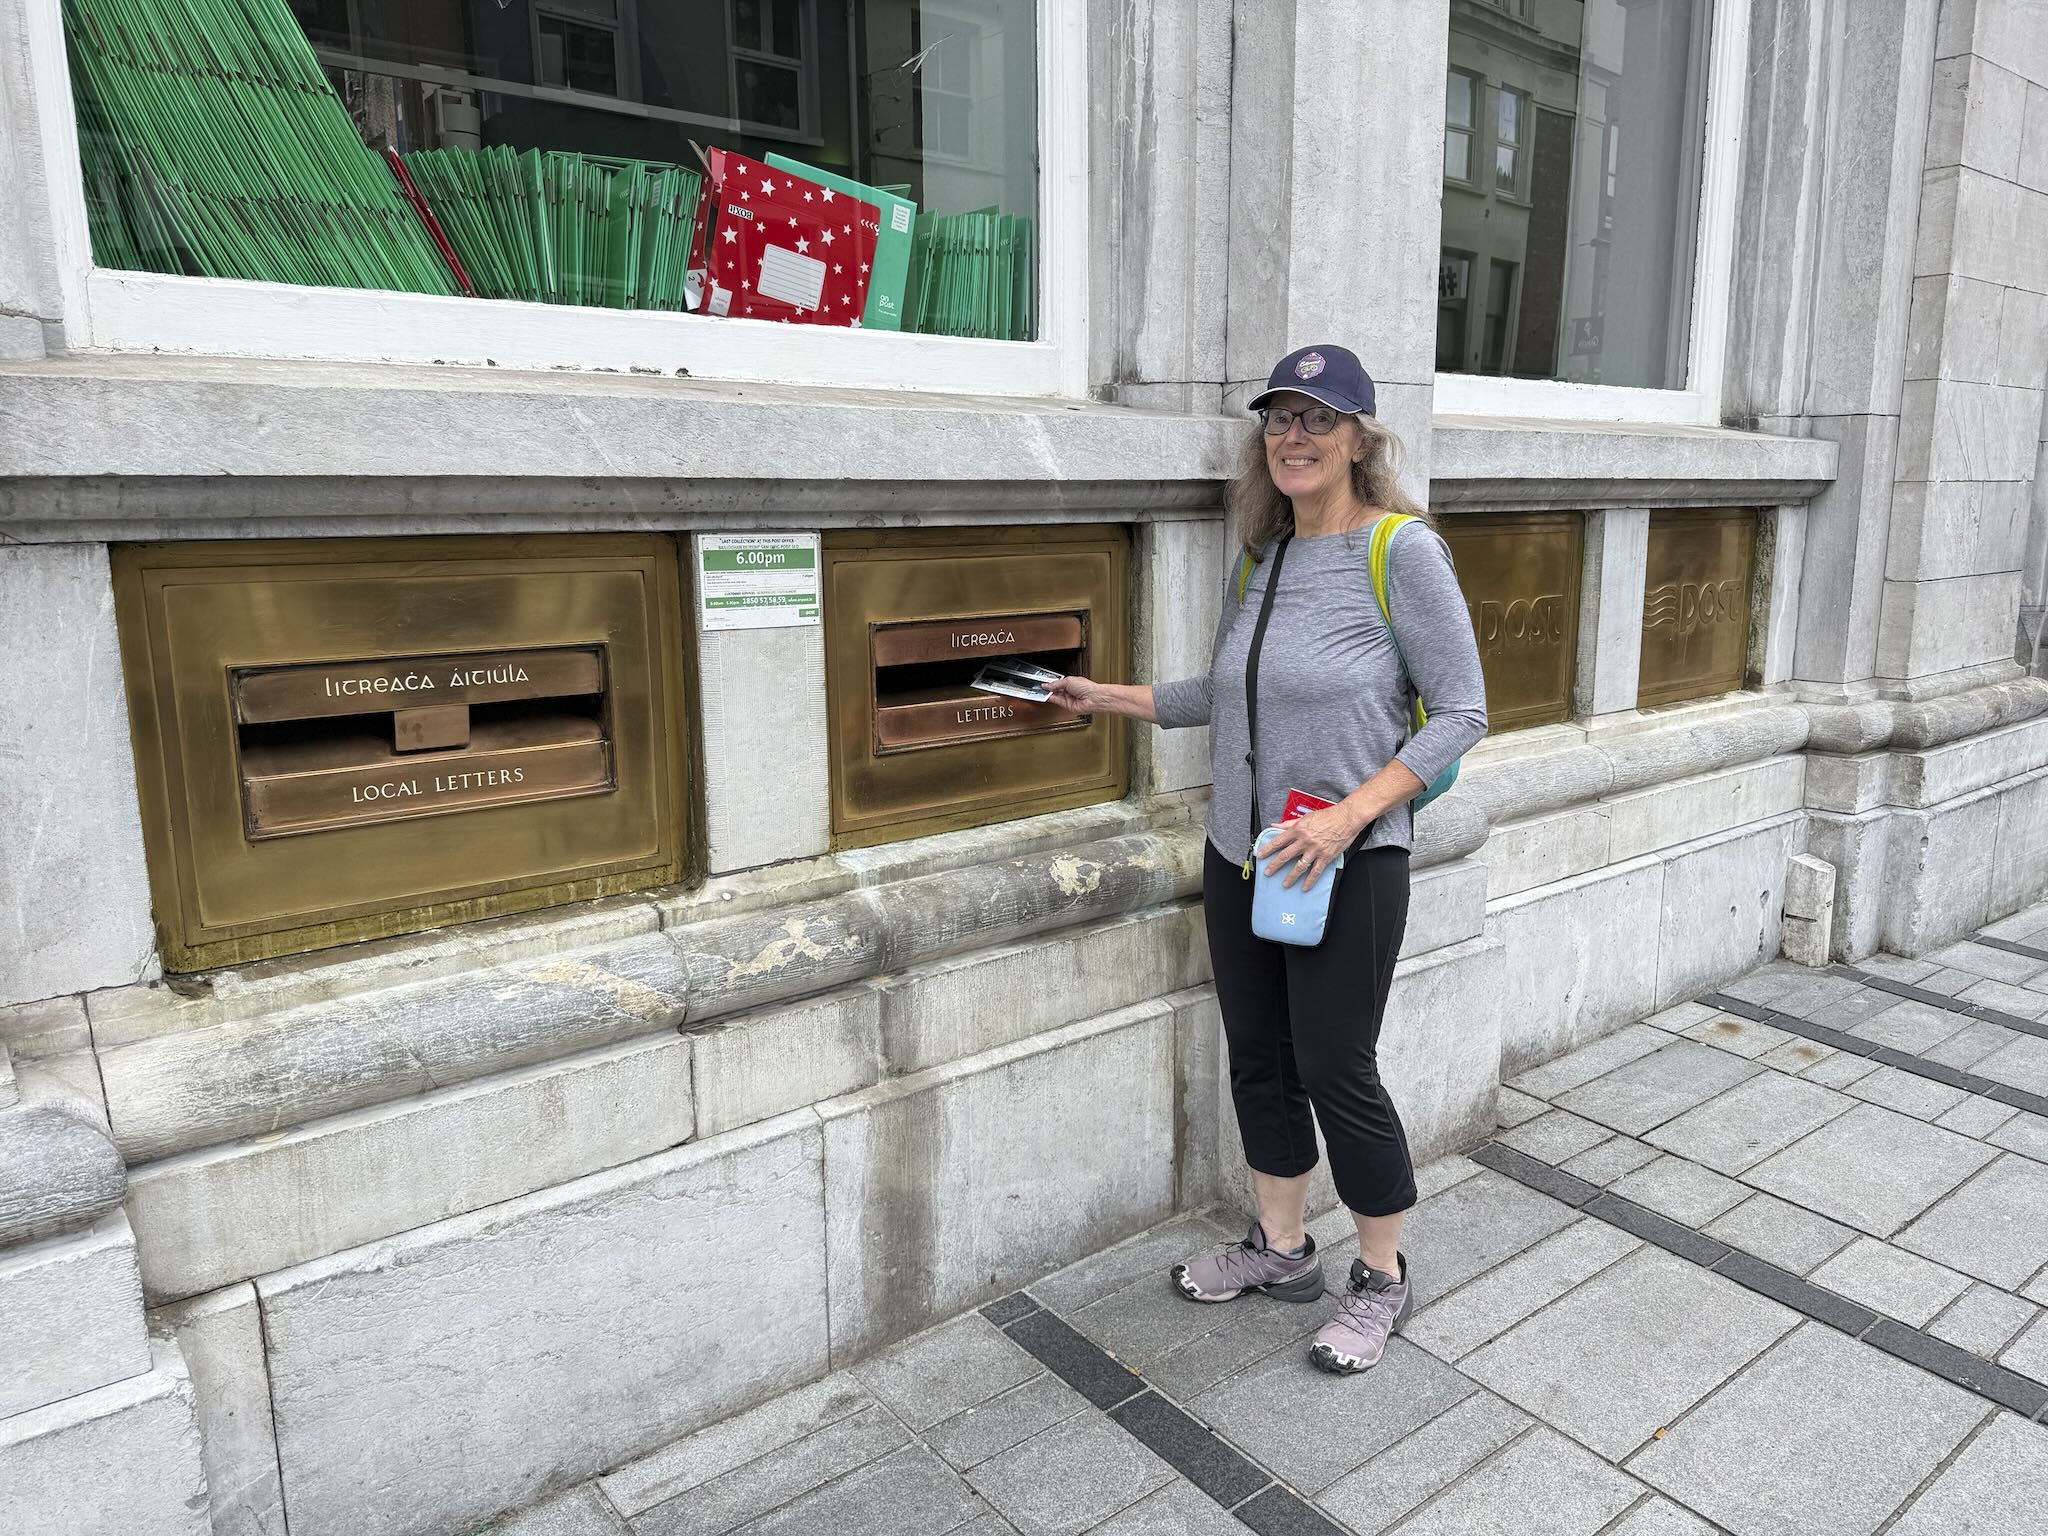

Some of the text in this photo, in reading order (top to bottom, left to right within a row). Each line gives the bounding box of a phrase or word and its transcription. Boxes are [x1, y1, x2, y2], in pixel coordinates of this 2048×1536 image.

[729, 205, 752, 220] BOXit
[736, 551, 785, 567] 6.00pm
[742, 597, 759, 605] 1850
[957, 705, 1014, 724] LETTERS
[352, 767, 524, 803] LOCAL LETTERS
